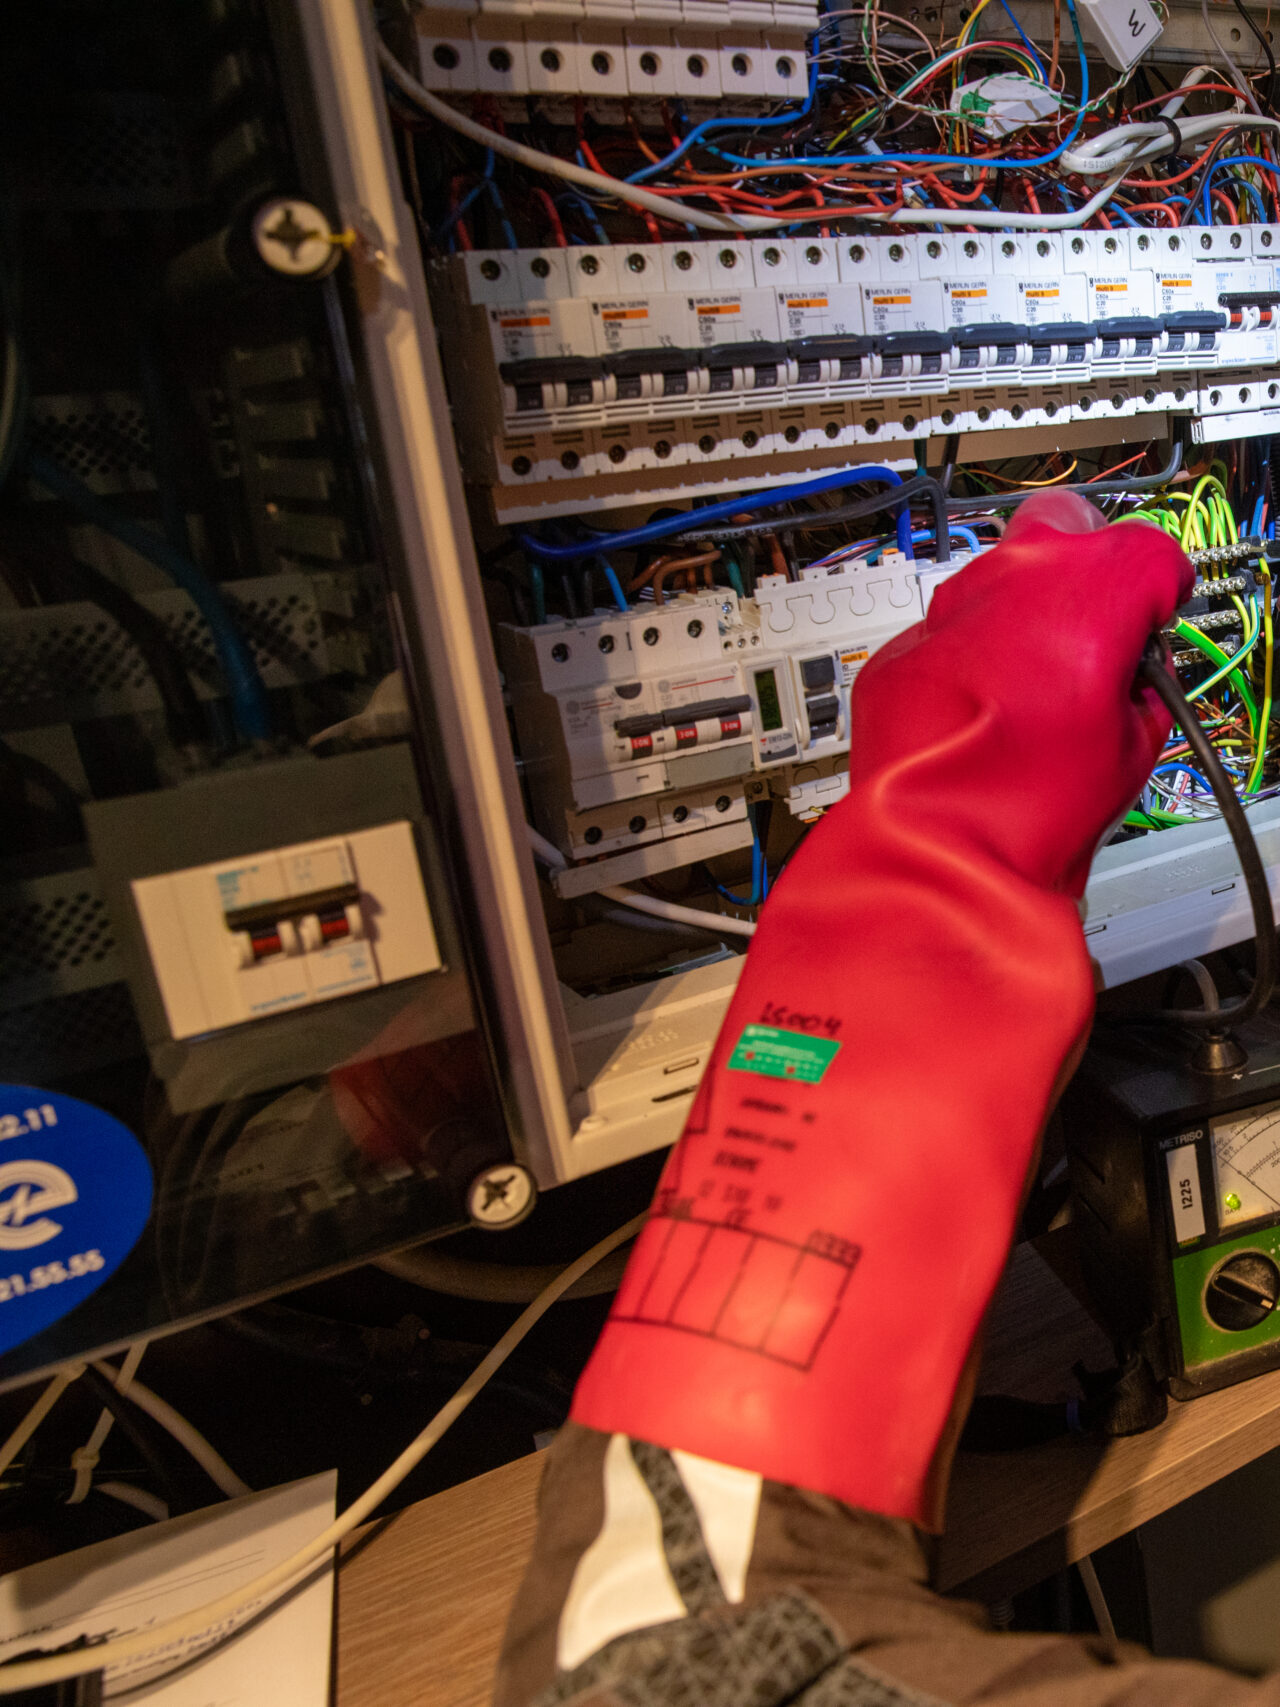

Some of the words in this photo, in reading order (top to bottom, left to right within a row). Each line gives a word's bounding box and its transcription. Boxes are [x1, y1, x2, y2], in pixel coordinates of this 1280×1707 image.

[0, 1103, 58, 1141] 2.11
[1159, 1129, 1204, 1149] METRISO
[1179, 1178, 1194, 1211] 1225
